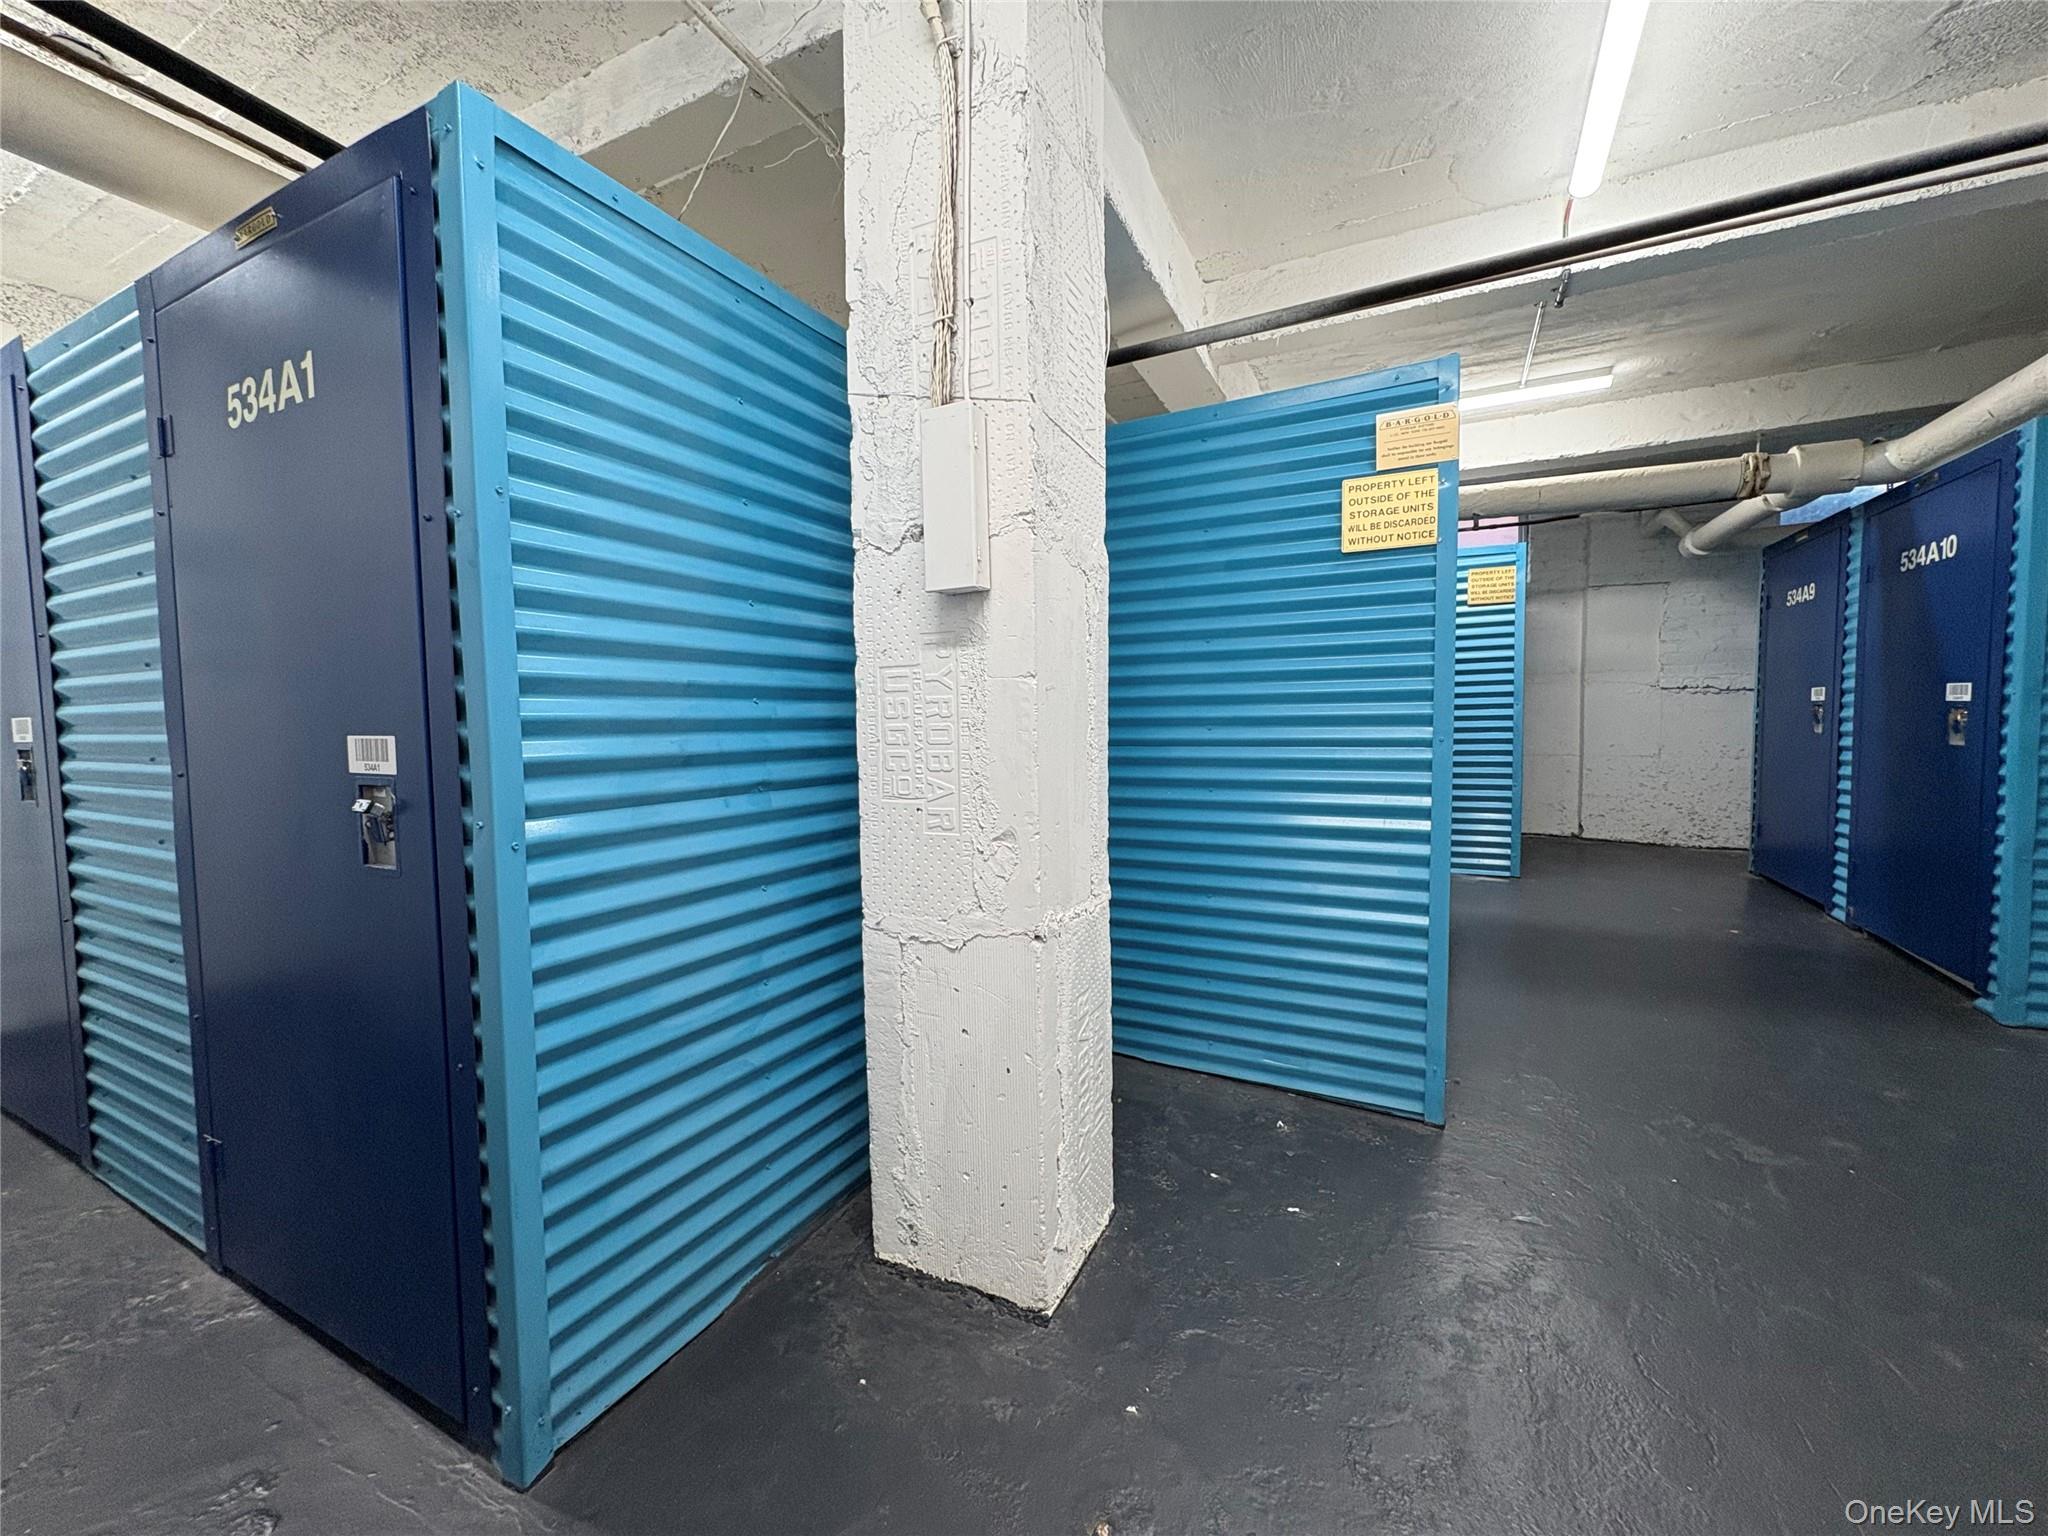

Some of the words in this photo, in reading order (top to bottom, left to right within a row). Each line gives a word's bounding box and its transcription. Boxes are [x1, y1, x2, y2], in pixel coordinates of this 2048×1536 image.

[227, 349, 315, 429] 534A1
[1348, 478, 1405, 494] PROPERTY
[1408, 475, 1436, 486] LEFT
[1348, 493, 1394, 507] OUTSIDE
[1396, 491, 1411, 501] OF
[1414, 489, 1435, 499] THE
[1349, 506, 1400, 520] STORAGE
[1402, 502, 1434, 513] UNITS
[1348, 523, 1368, 533] WILL
[1370, 521, 1382, 531] BE
[1383, 516, 1436, 529] DISCARDED
[1348, 533, 1395, 546] WITHOUT
[1397, 529, 1436, 541] NOTICE
[1900, 534, 1958, 572] 534A10
[1786, 582, 1816, 606] 534A9
[363, 763, 381, 772] 534A1
